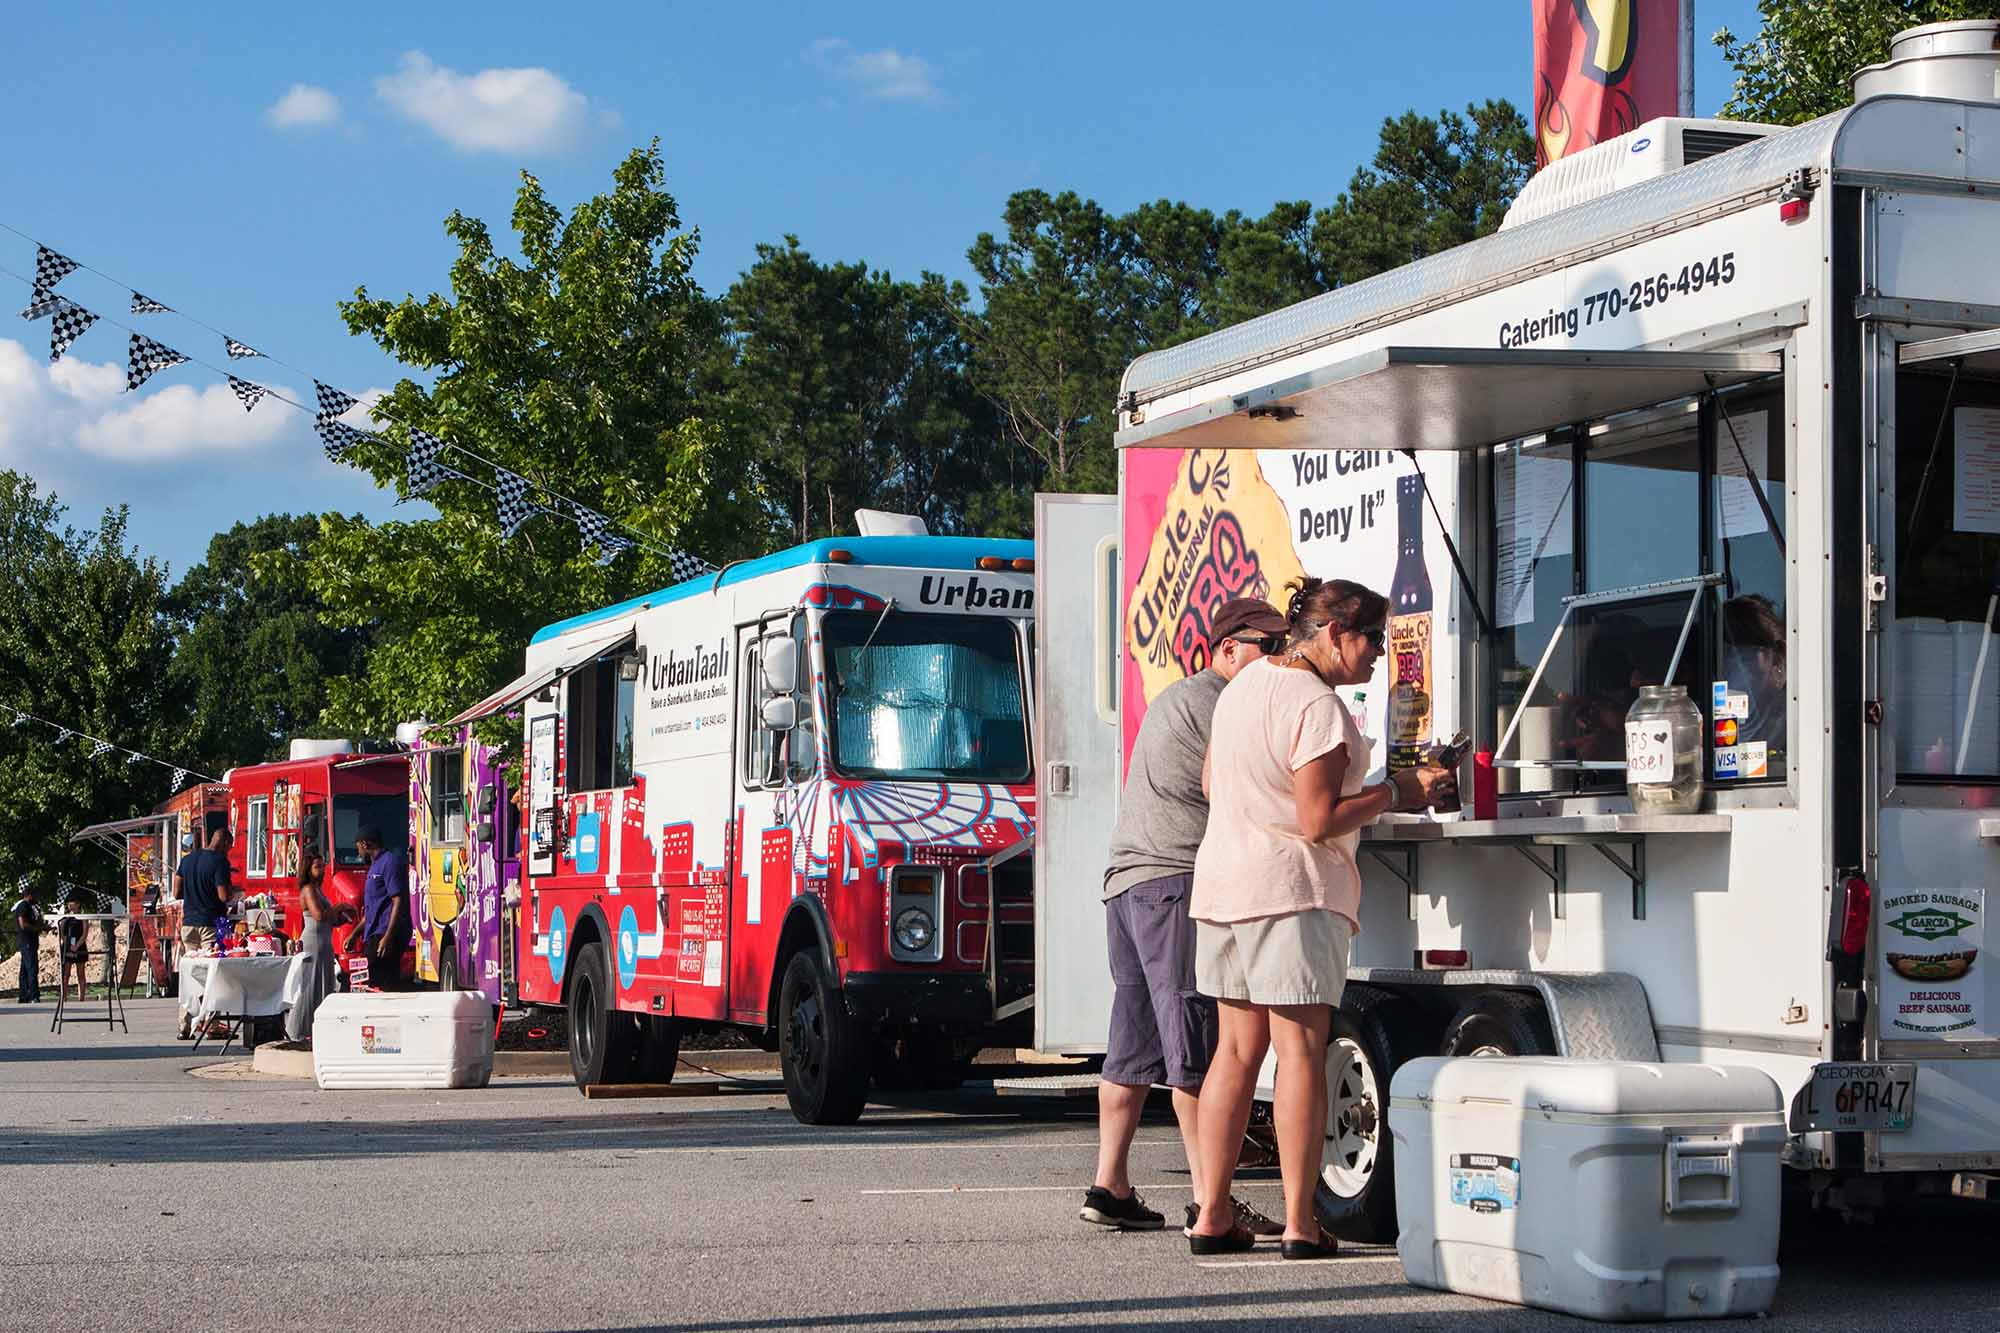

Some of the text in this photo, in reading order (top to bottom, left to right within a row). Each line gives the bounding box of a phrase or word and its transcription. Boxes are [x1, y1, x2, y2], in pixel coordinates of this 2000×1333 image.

[1499, 252, 1736, 349] Catering 770-256-4945
[1292, 451, 1328, 487] You
[1299, 506, 1353, 543] Deny
[1134, 508, 1192, 648] Uncle
[1168, 503, 1214, 620] ORIGINAL
[920, 576, 1034, 610] Urban
[1172, 509, 1260, 677] BBQ
[1392, 622, 1415, 641] Uncle
[652, 637, 728, 691] UrbanTaali
[1396, 649, 1425, 690] BBQ
[650, 697, 663, 709] Have
[693, 688, 707, 701] Have
[1717, 752, 1737, 767] VISA
[1884, 894, 1980, 913] SMOKED SAUSAGE
[1911, 917, 1950, 928] GARCIA
[1899, 1004, 1972, 1014] BEEF SAUSAGE
[1909, 991, 1961, 1001] DELICIOUS
[1819, 1066, 1885, 1080] GEORGIA
[1835, 1081, 1911, 1114] 6PR47
